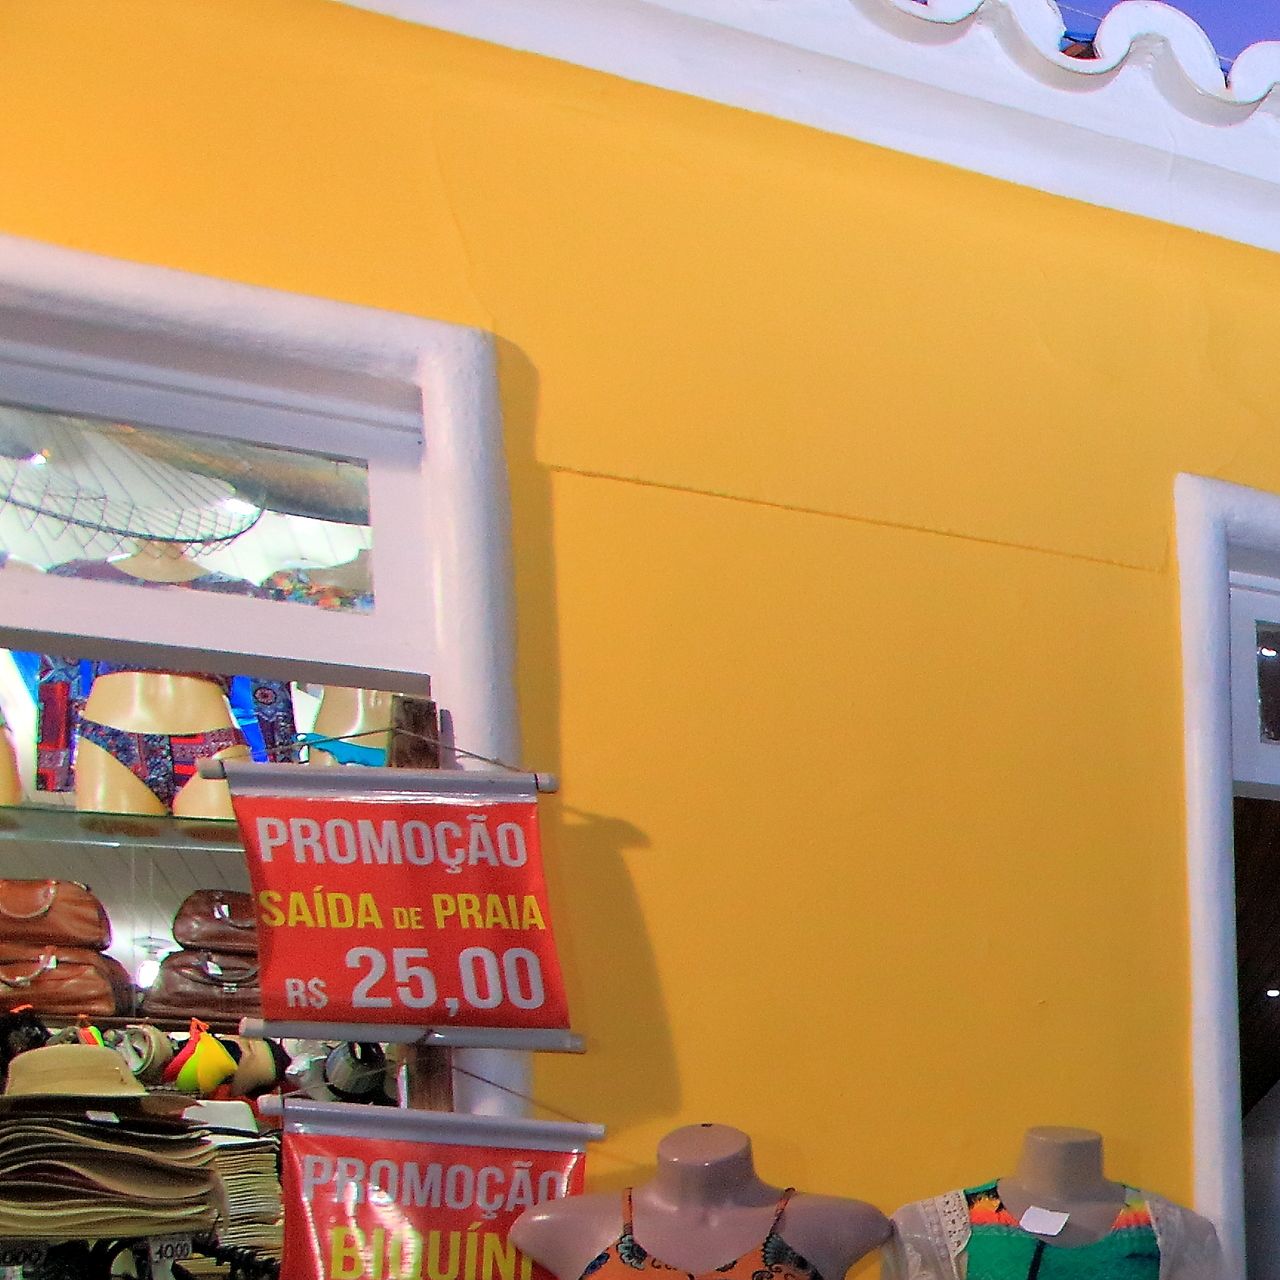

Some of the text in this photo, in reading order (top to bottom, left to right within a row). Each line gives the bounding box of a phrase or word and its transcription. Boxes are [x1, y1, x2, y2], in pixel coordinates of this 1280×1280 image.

[256, 814, 528, 874] PROMOÇÃO
[260, 886, 546, 930] SAÍDA DE PRAIA
[285, 946, 545, 1017] R$ 25,00
[303, 1154, 564, 1220] PROMOÇÃO
